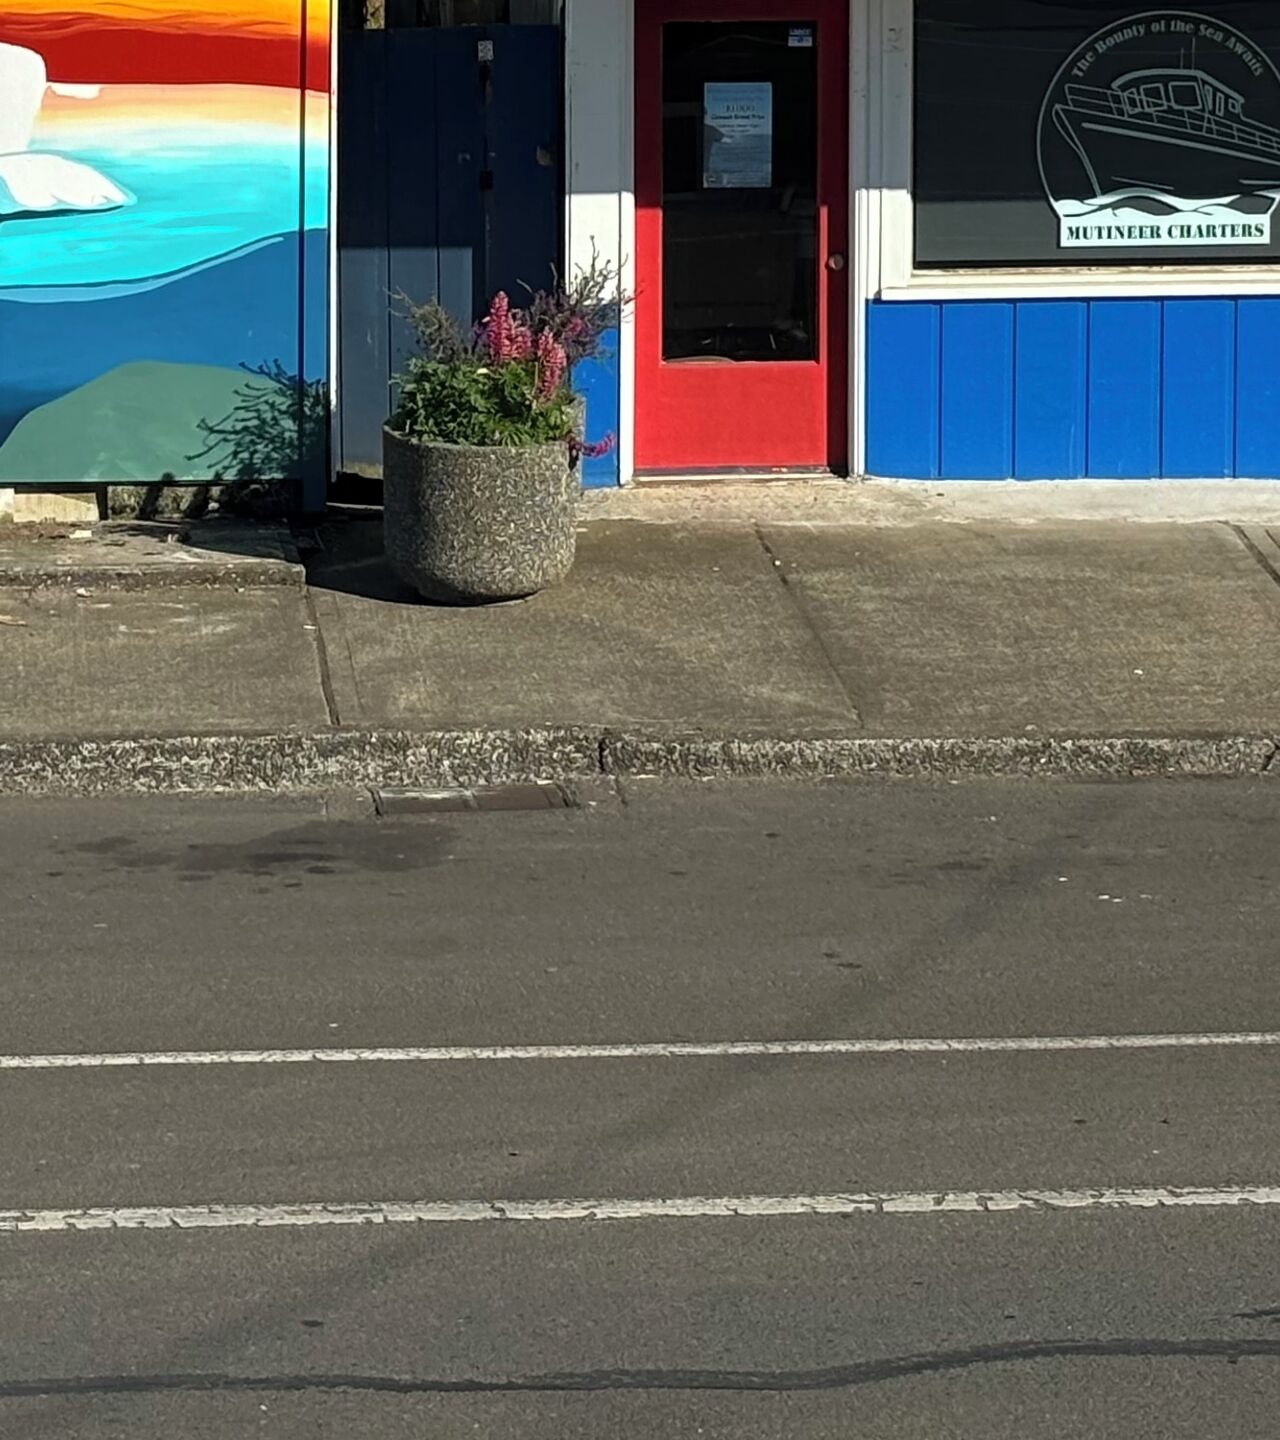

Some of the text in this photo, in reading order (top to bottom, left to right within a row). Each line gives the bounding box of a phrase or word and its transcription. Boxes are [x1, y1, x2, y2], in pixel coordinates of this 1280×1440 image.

[1071, 19, 1264, 78] The Bounty of the Sea Awaits
[1067, 223, 1265, 240] MUTINEER CHARTERS
